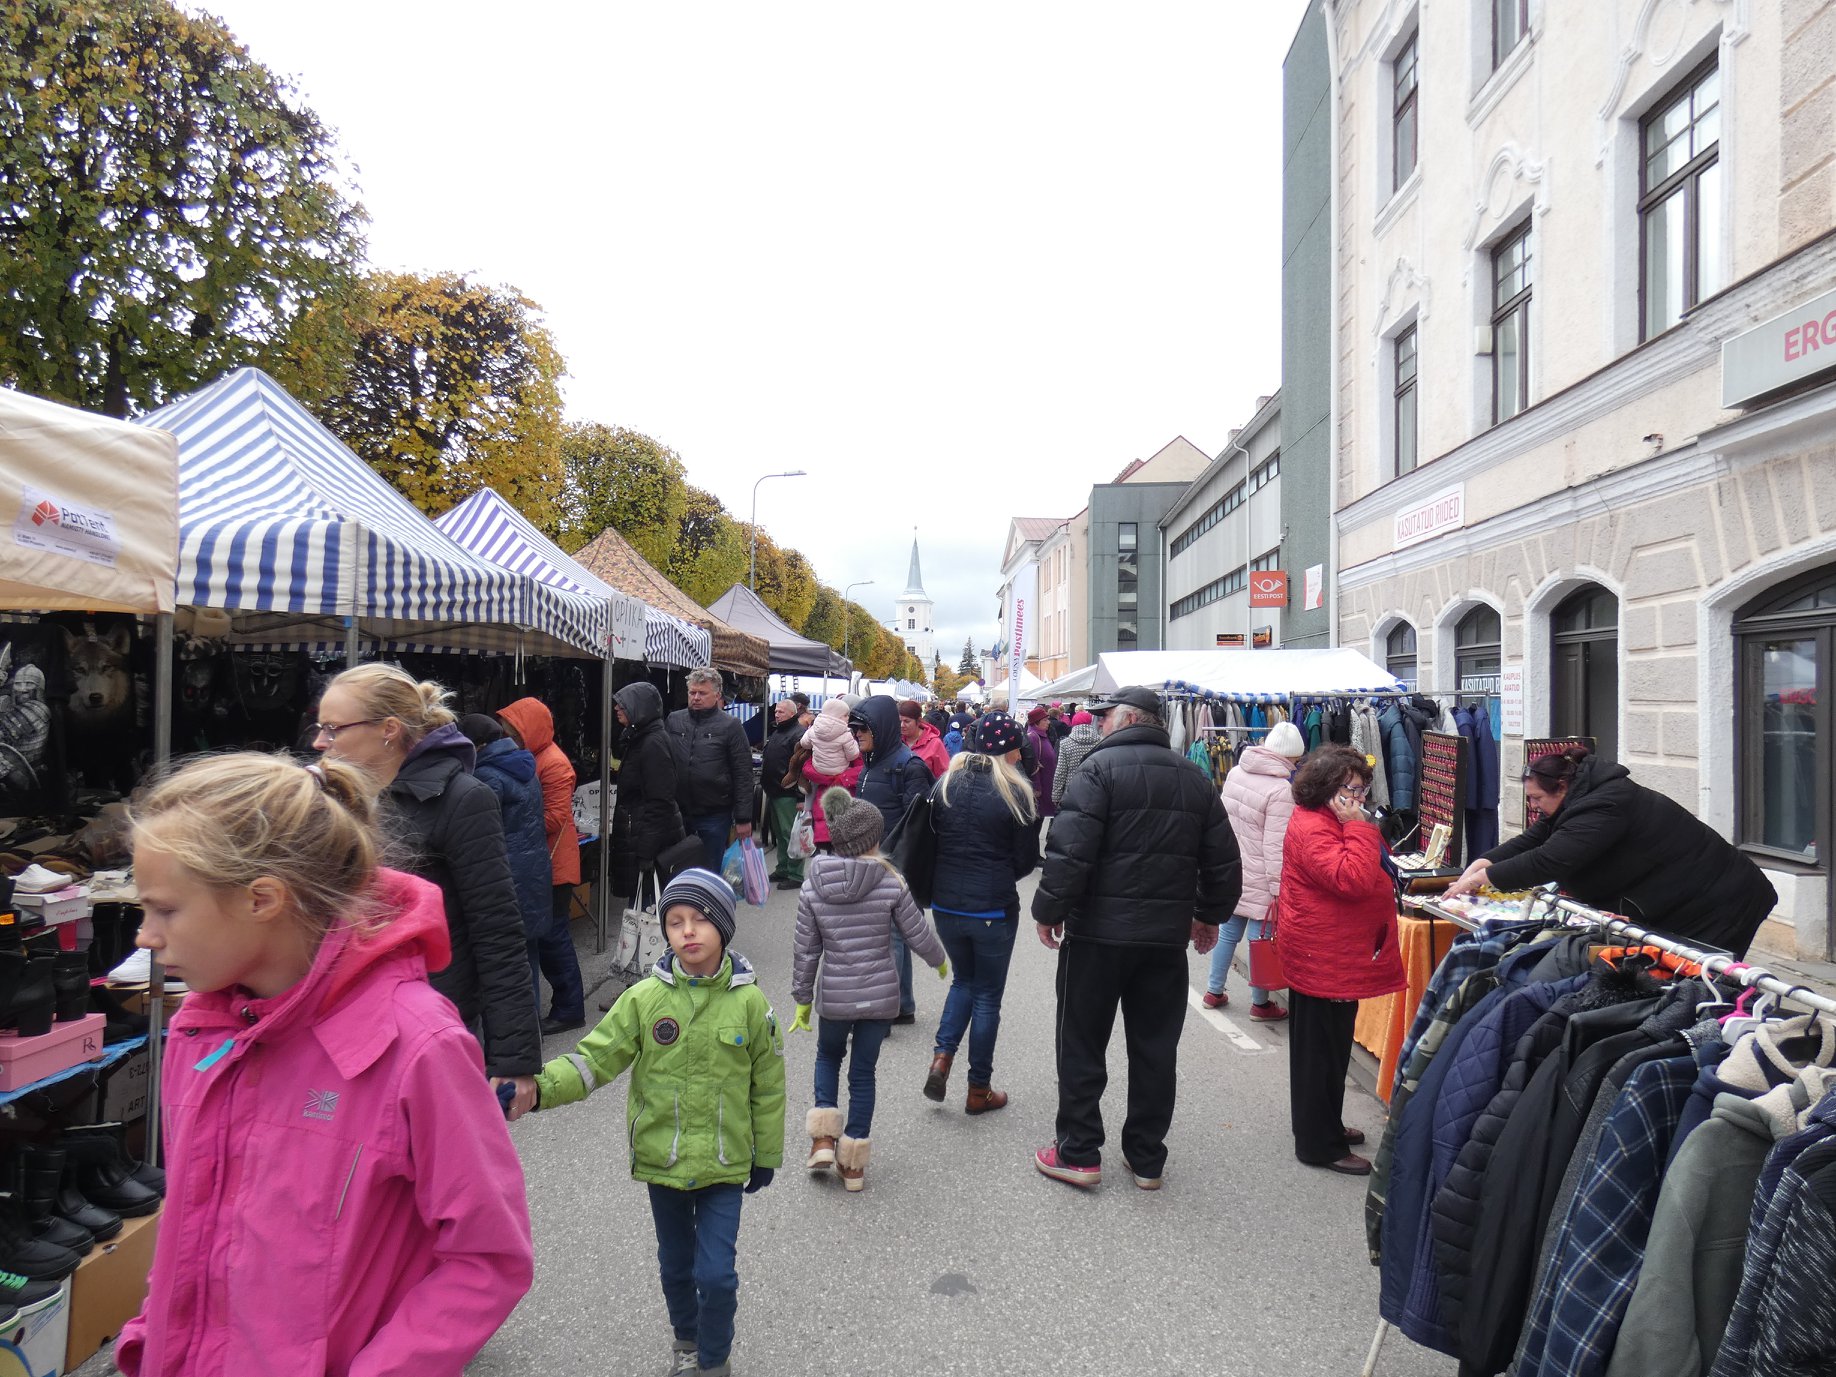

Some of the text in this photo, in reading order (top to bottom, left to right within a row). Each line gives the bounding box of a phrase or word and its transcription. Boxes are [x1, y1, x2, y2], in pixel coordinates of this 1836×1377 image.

[1398, 496, 1460, 540] KASUTATUD RIIDED
[615, 596, 643, 629] OPTIKA
